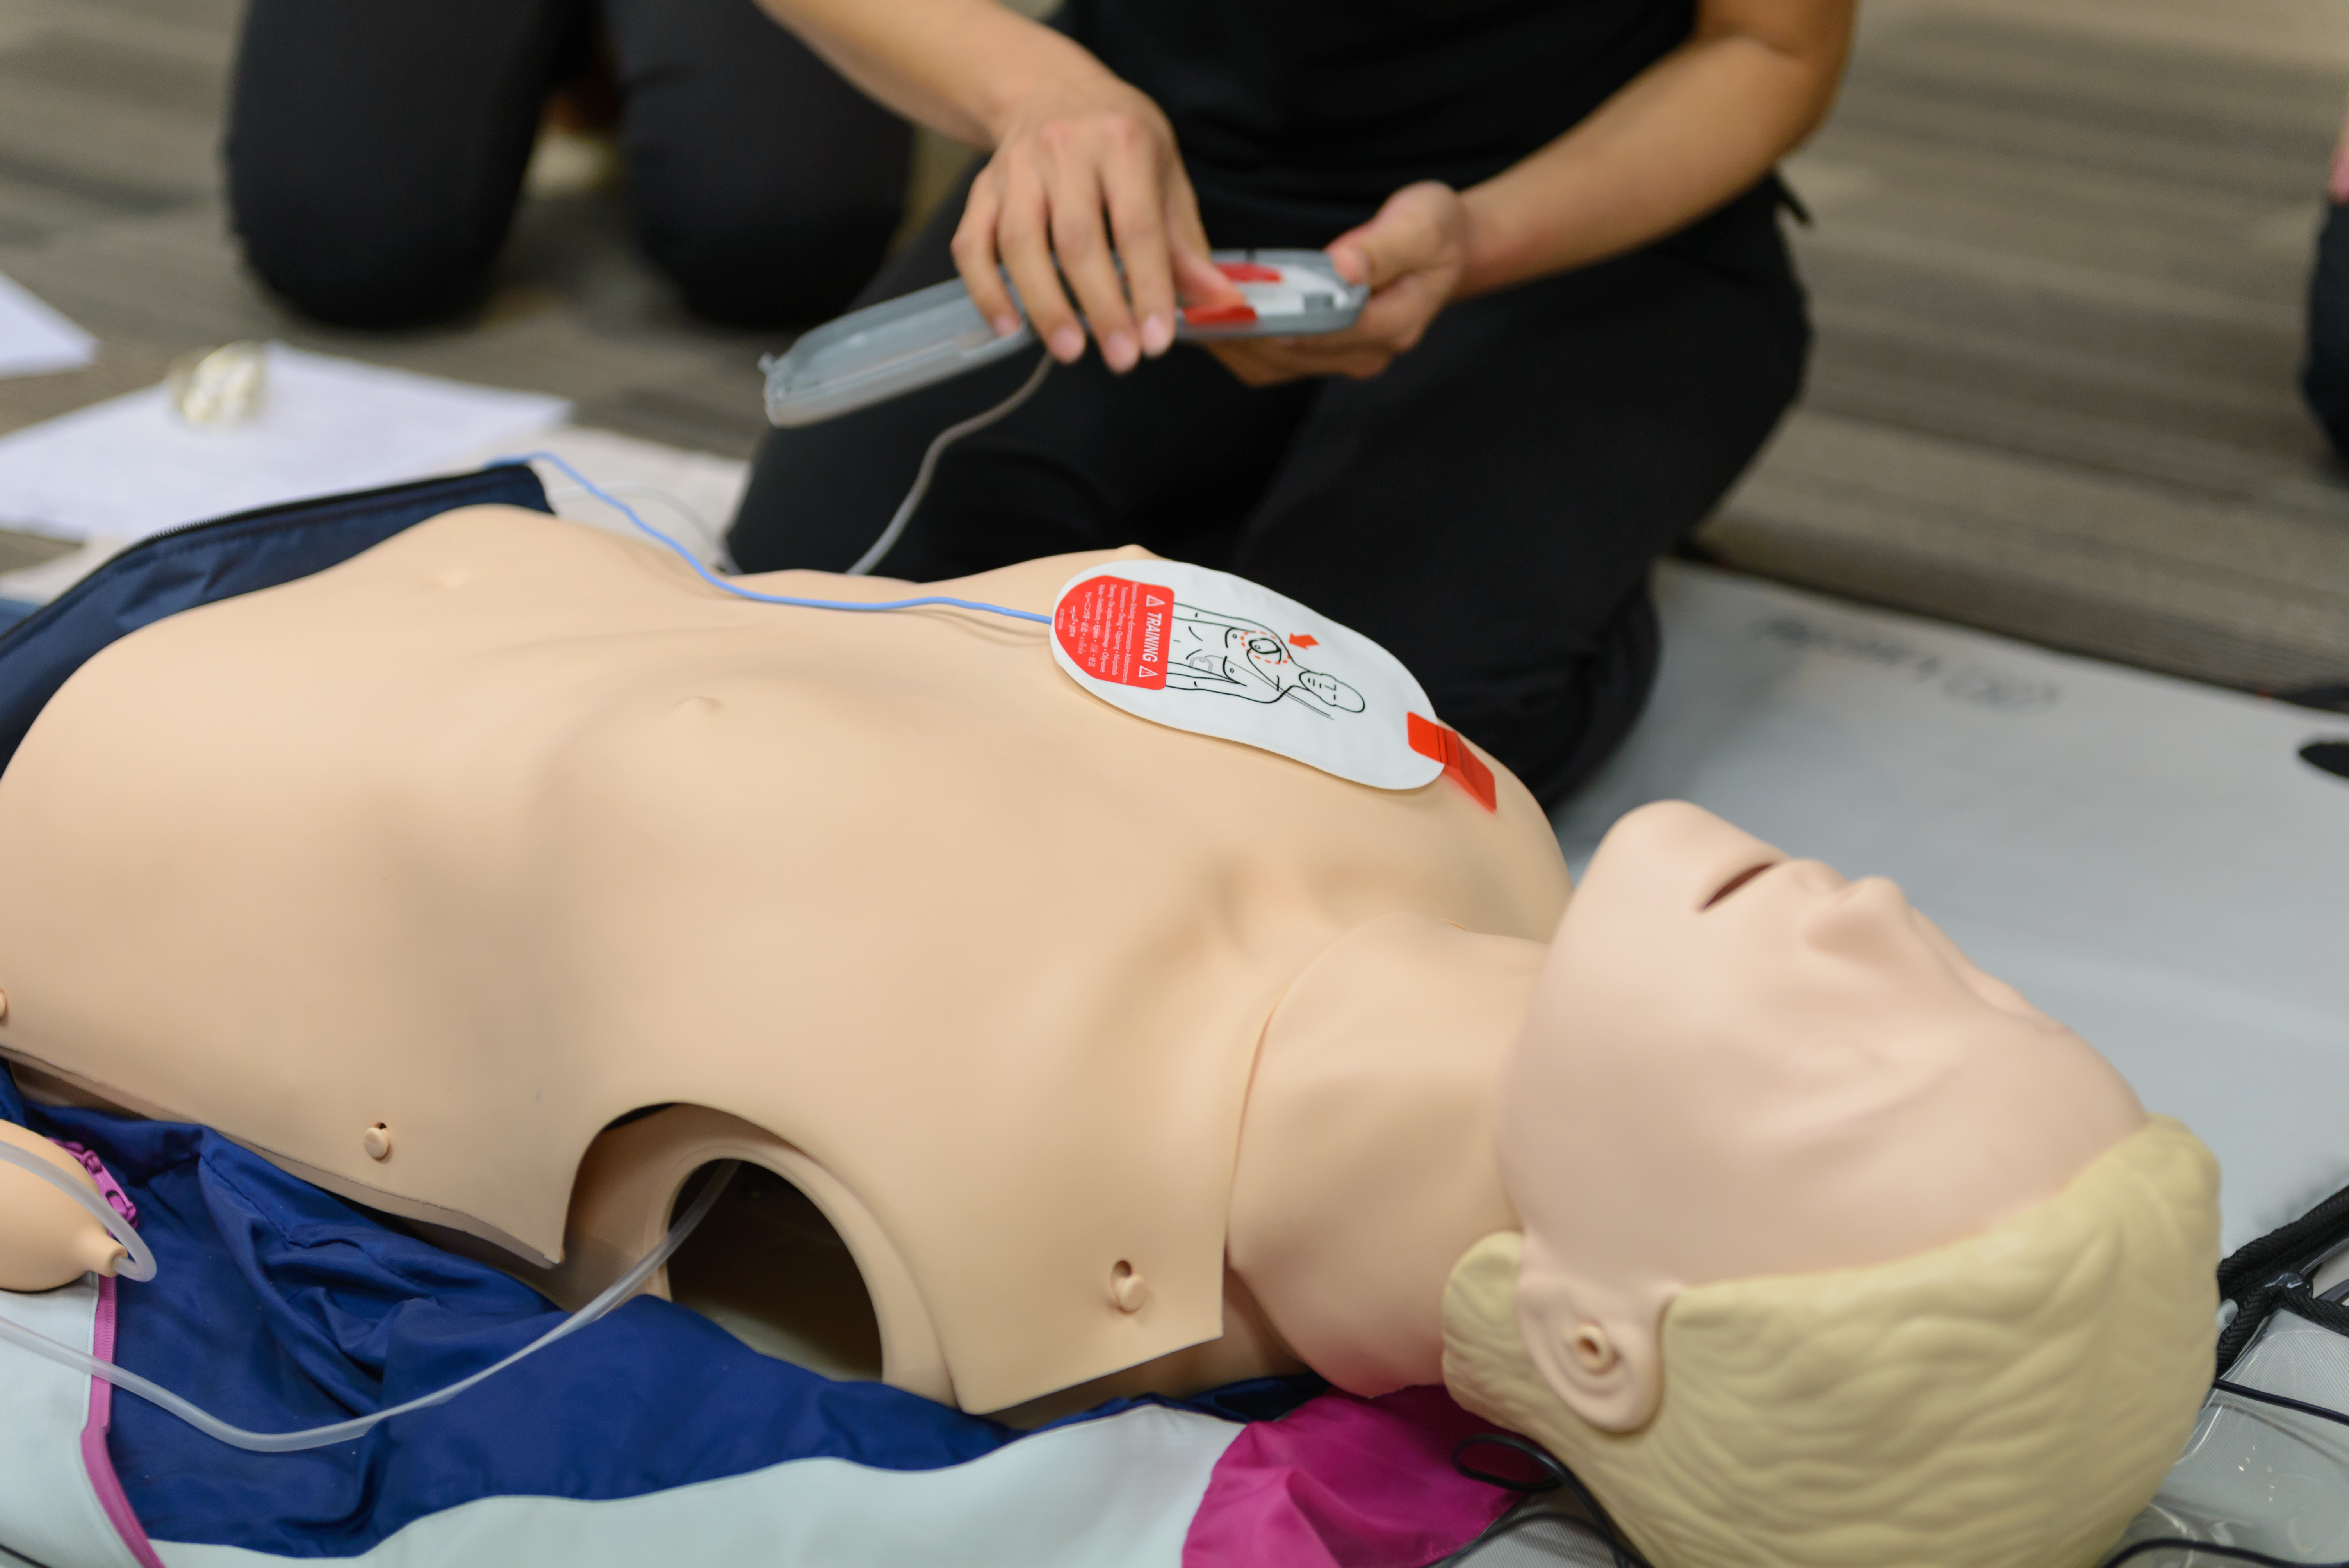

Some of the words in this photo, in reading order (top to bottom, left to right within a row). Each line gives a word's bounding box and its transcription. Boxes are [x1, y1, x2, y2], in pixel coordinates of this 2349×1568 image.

[1142, 612, 1162, 663] TRAINING
[1100, 652, 1109, 673] Обучение
[1111, 654, 1121, 676] Harjoittelu
[1122, 652, 1132, 684] Addestramento
